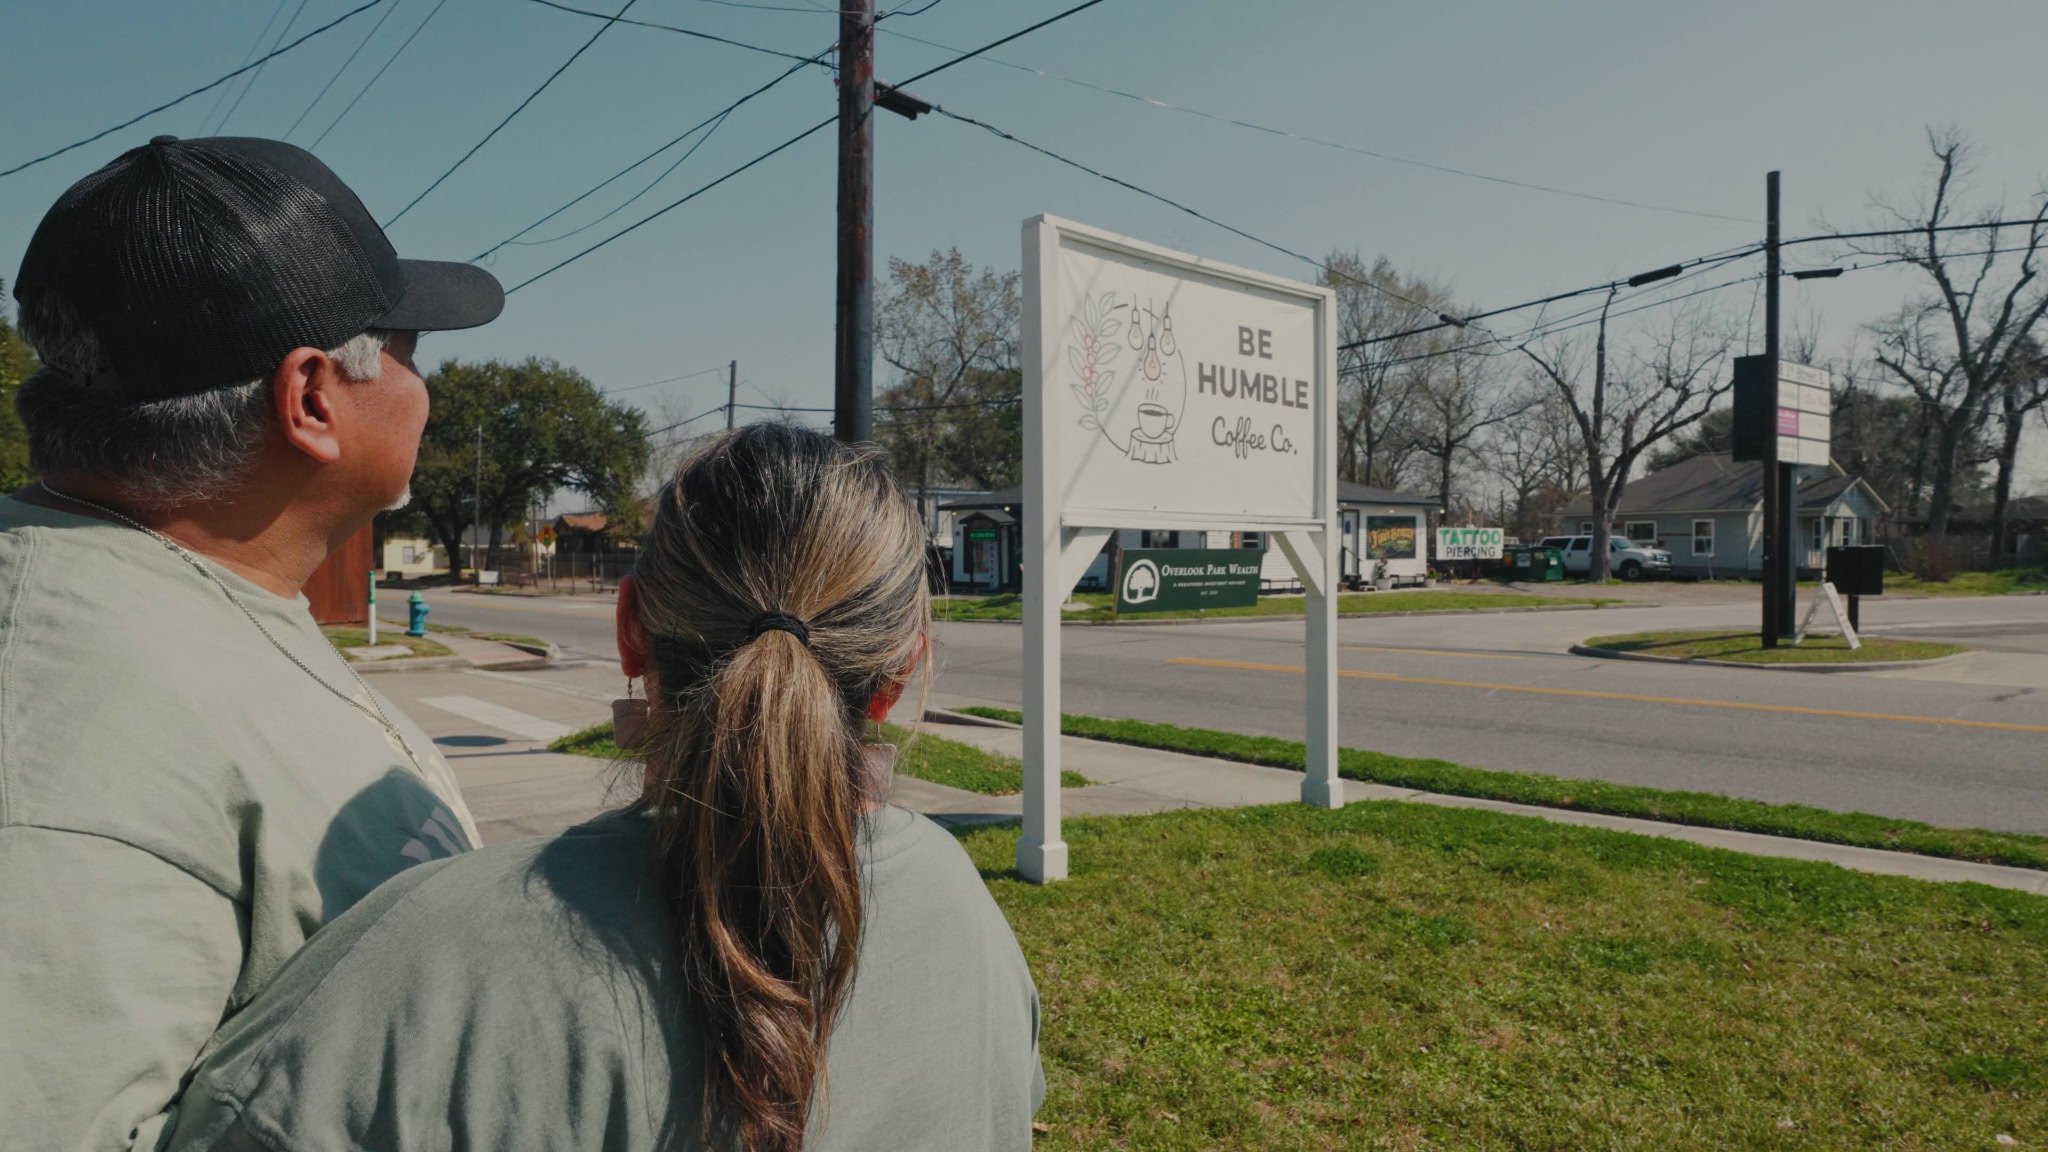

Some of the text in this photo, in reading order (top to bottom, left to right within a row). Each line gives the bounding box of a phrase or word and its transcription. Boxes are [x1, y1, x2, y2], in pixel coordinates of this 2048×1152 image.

[1238, 325, 1273, 360] BE
[1198, 362, 1309, 410] HUMBLE
[1212, 416, 1297, 460] Coffee Co.
[1439, 529, 1502, 546] TATTOO
[1446, 546, 1496, 558] PIERCING
[1161, 563, 1259, 577] OVERLOOK PARK WEALTH
